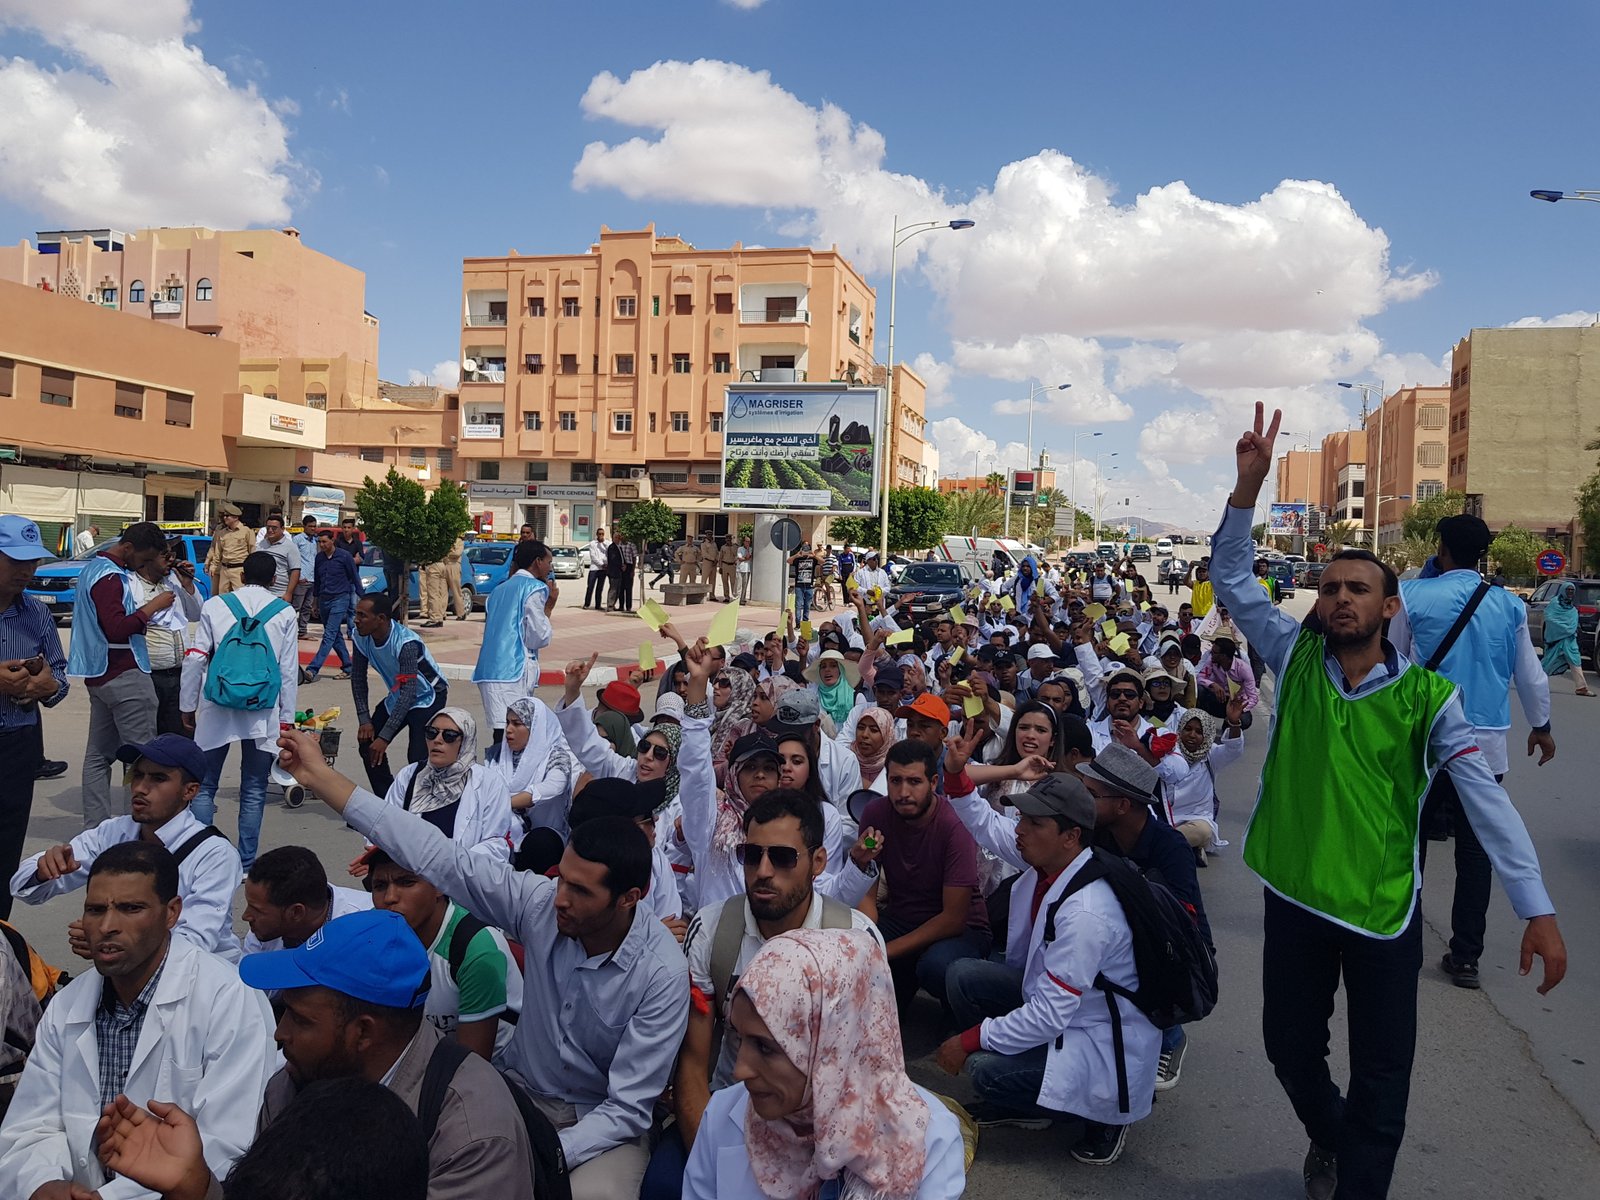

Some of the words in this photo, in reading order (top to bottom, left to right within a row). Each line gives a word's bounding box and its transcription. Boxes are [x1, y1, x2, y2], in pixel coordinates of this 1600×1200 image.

[748, 400, 804, 408] MAGRISER
[763, 436, 774, 446] مع
[775, 435, 798, 446] الفلاح
[729, 448, 749, 459] مرتاح
[769, 446, 789, 458] أرضك
